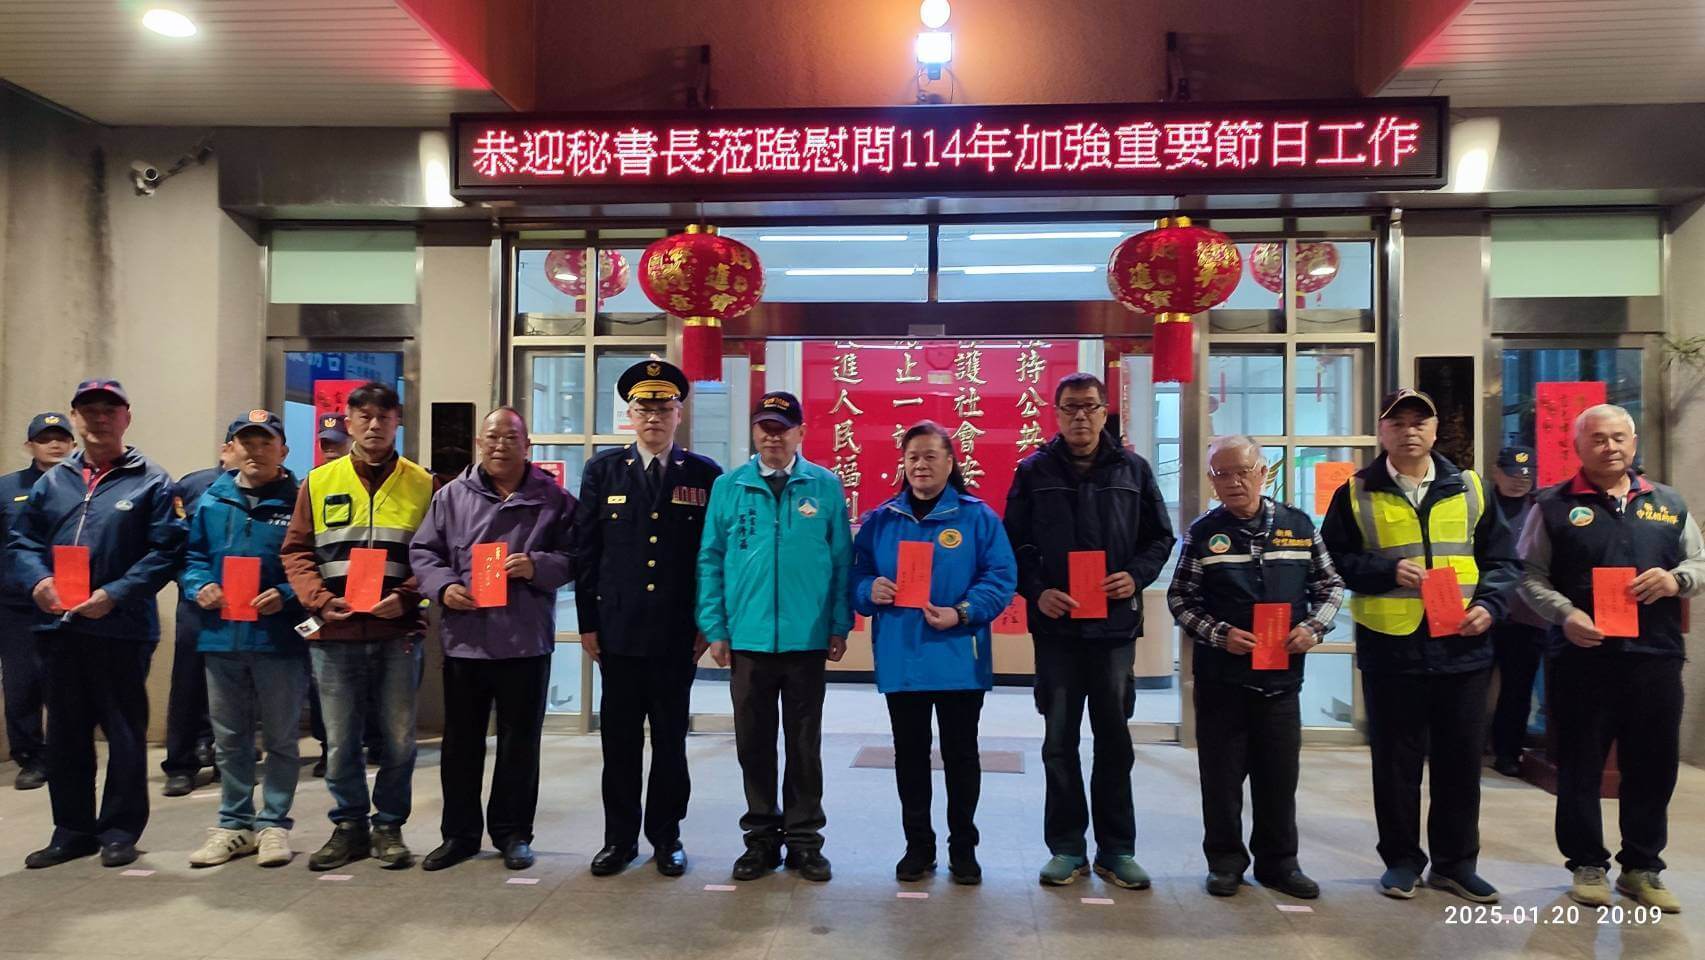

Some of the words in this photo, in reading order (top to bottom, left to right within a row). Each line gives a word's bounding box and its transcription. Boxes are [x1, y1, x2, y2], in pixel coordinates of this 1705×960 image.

[473, 117, 1419, 176] 恭迎秘書長蒞臨慰問114年加強重要節日工作
[829, 340, 864, 524] 進人民福
[952, 340, 987, 489] 護社會安
